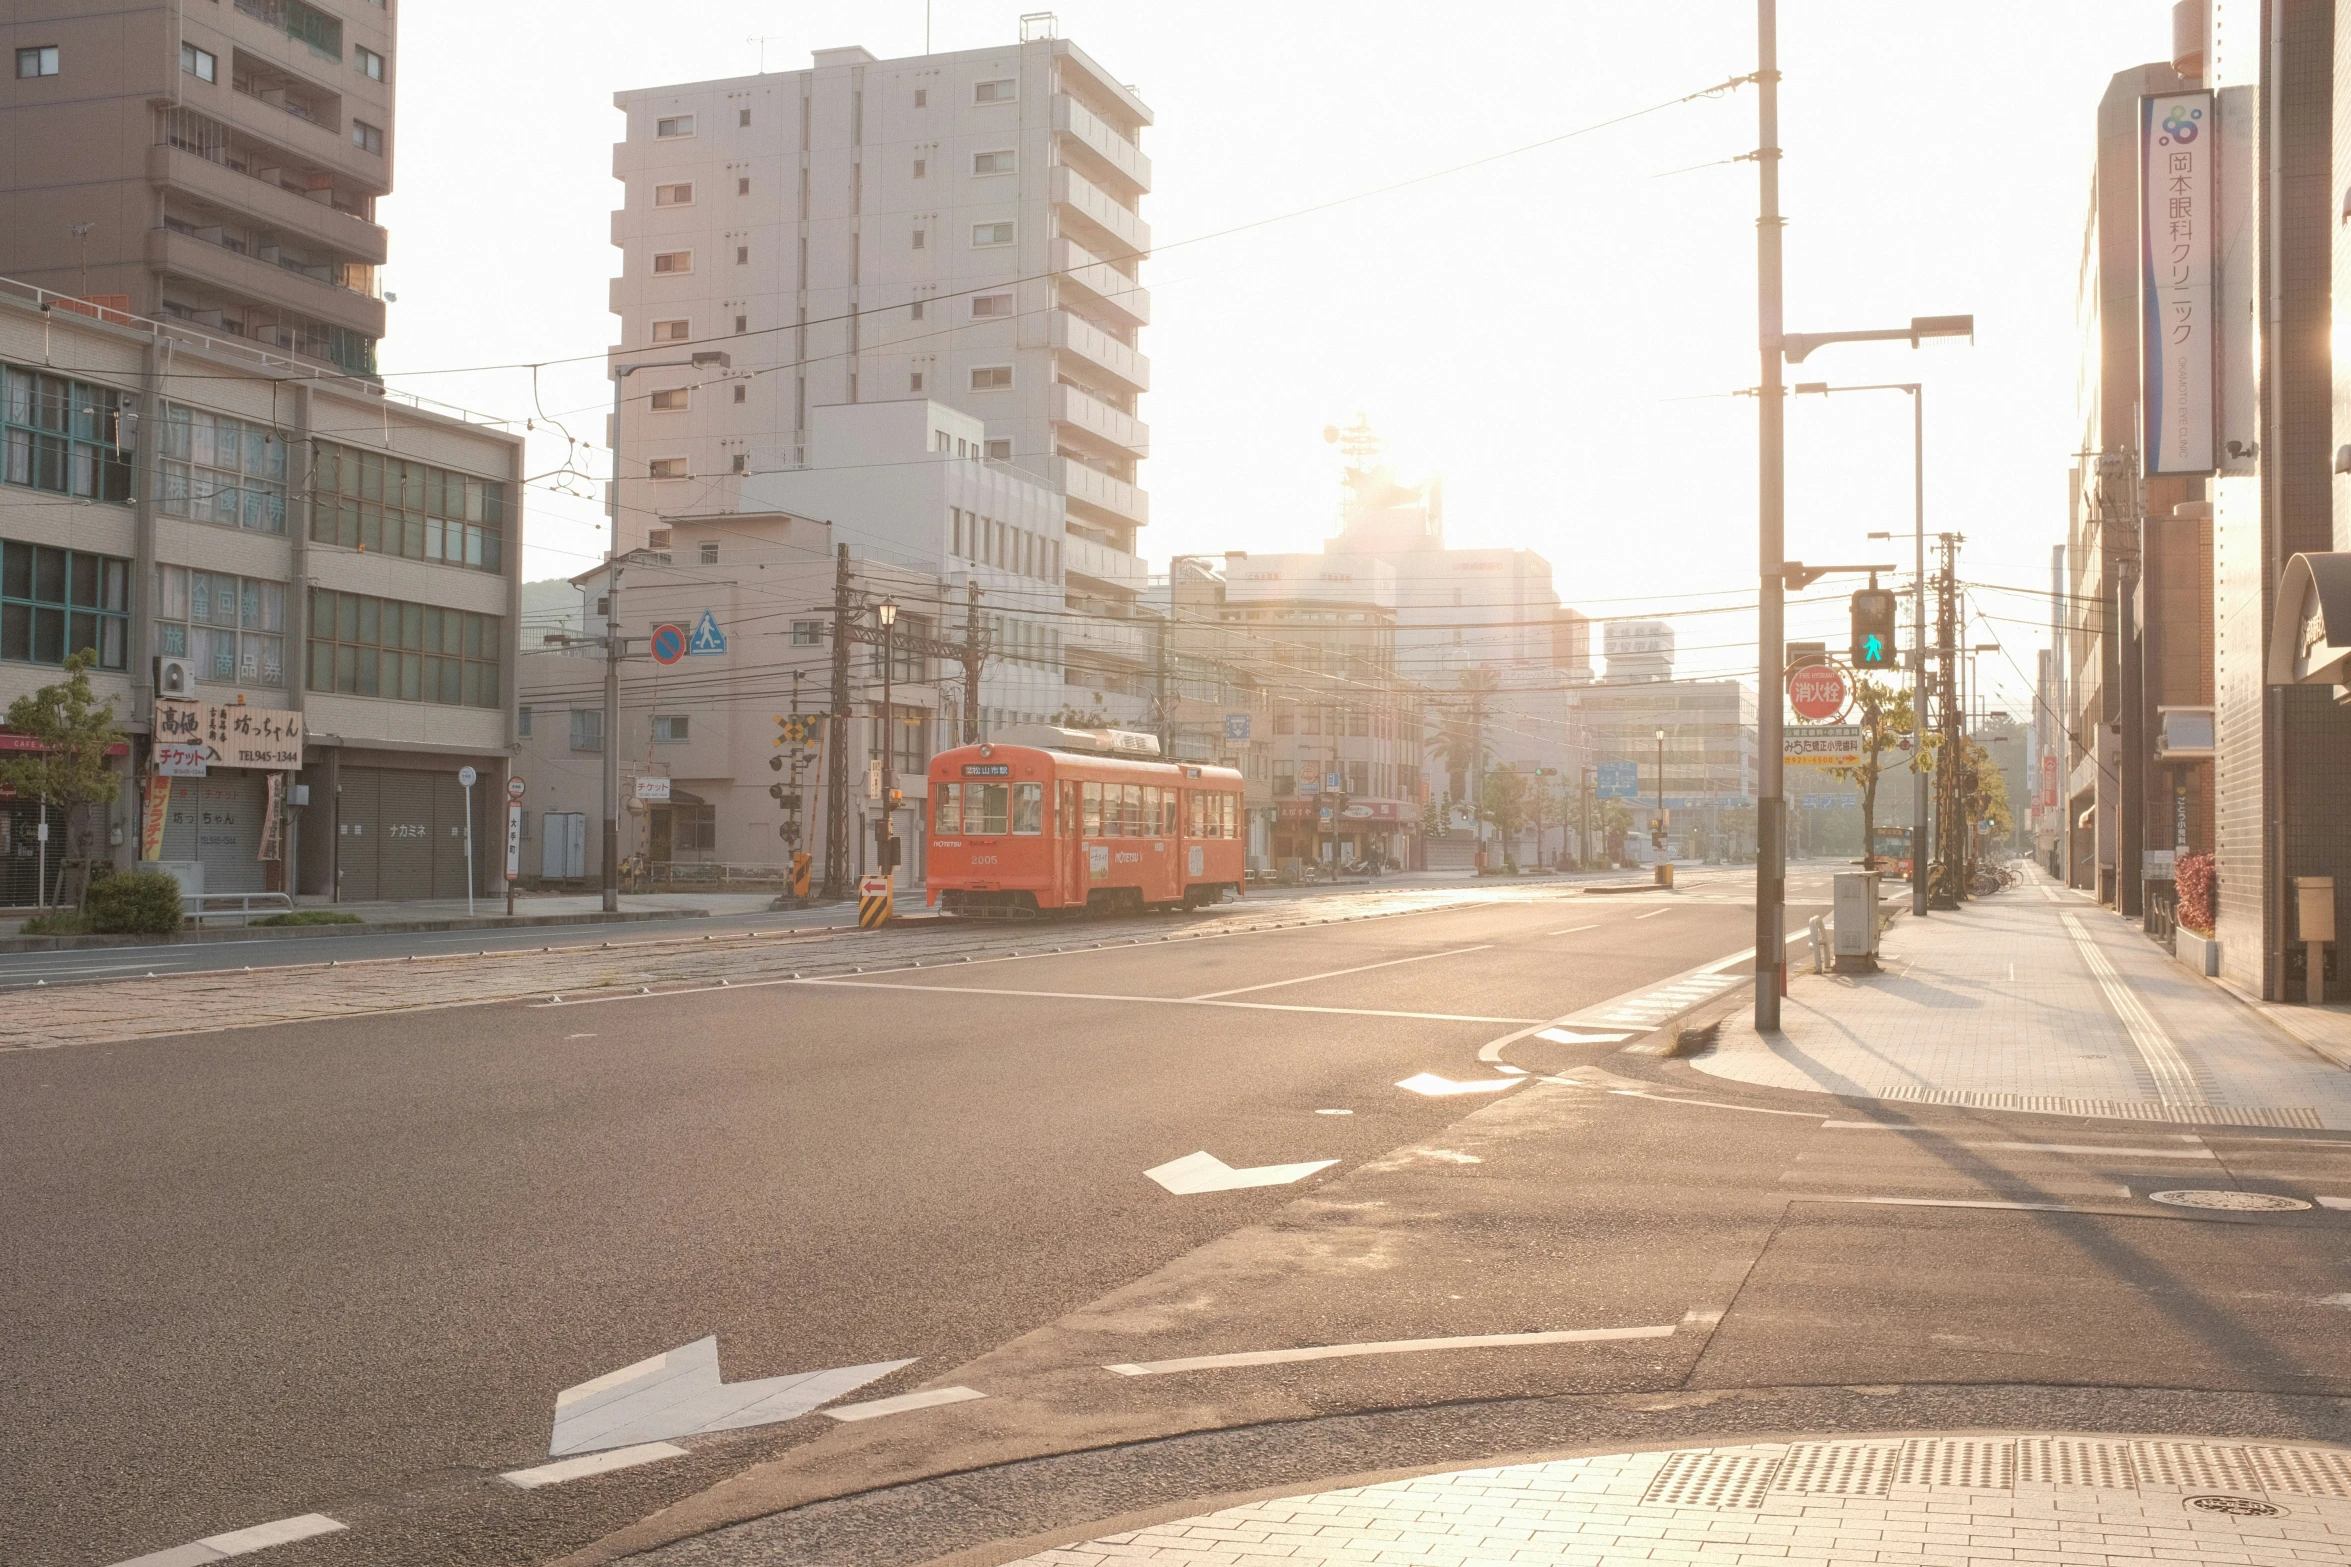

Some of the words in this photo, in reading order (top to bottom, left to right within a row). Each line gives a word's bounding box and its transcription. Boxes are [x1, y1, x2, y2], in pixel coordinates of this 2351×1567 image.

[2169, 152, 2192, 345] 岡本眼科クリニック
[2178, 356, 2188, 405] OKAMOTO
[2178, 407, 2188, 425] EYE
[2178, 427, 2188, 458] CLINIC
[1795, 681, 1840, 703] 消火栓
[233, 714, 299, 742] 坊っちゃん
[13, 740, 36, 748] CAFE
[160, 749, 206, 767] チケット
[973, 765, 1008, 775] 松山市駅
[637, 782, 669, 791] チケット
[173, 811, 235, 825] 坊っちゃん
[389, 823, 427, 838] ナカミネ
[509, 818, 517, 854] 大手町
[971, 856, 998, 865] 2005
